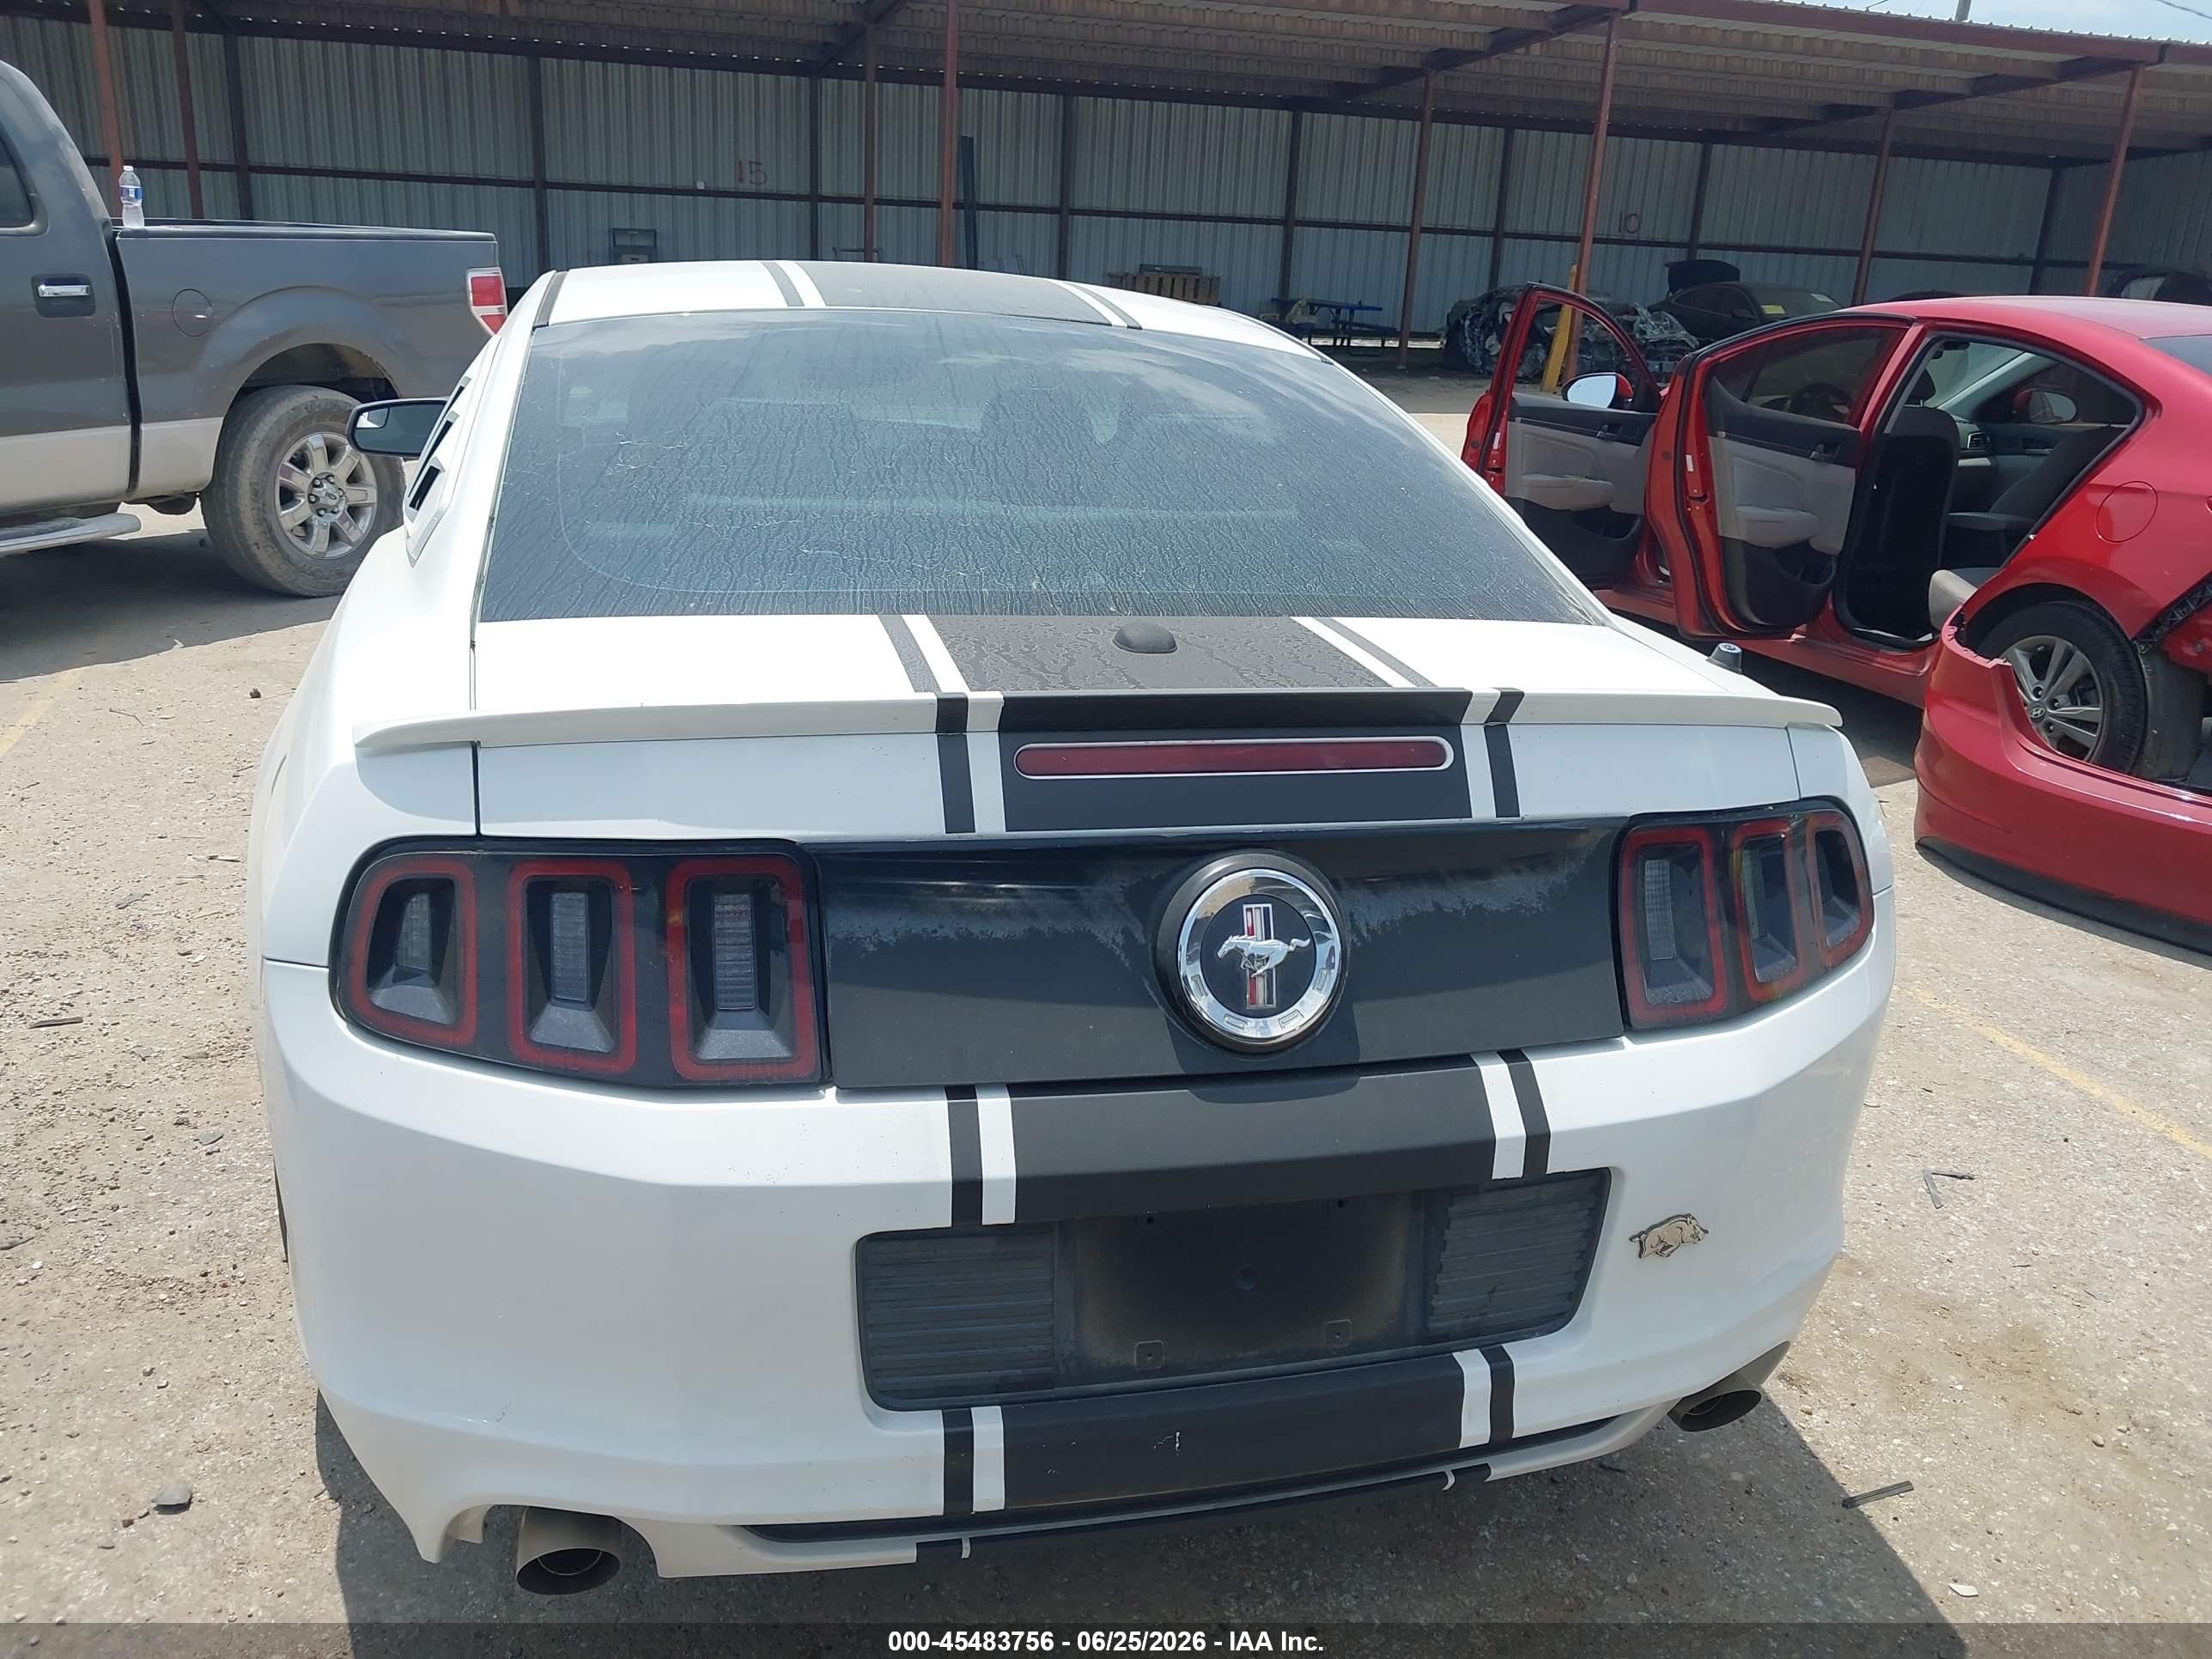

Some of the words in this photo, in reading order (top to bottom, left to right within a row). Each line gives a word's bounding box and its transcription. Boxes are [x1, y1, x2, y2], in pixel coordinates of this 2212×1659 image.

[738, 161, 768, 185] 15
[1618, 212, 1642, 234] 10
[1190, 967, 1329, 1030] FORD
